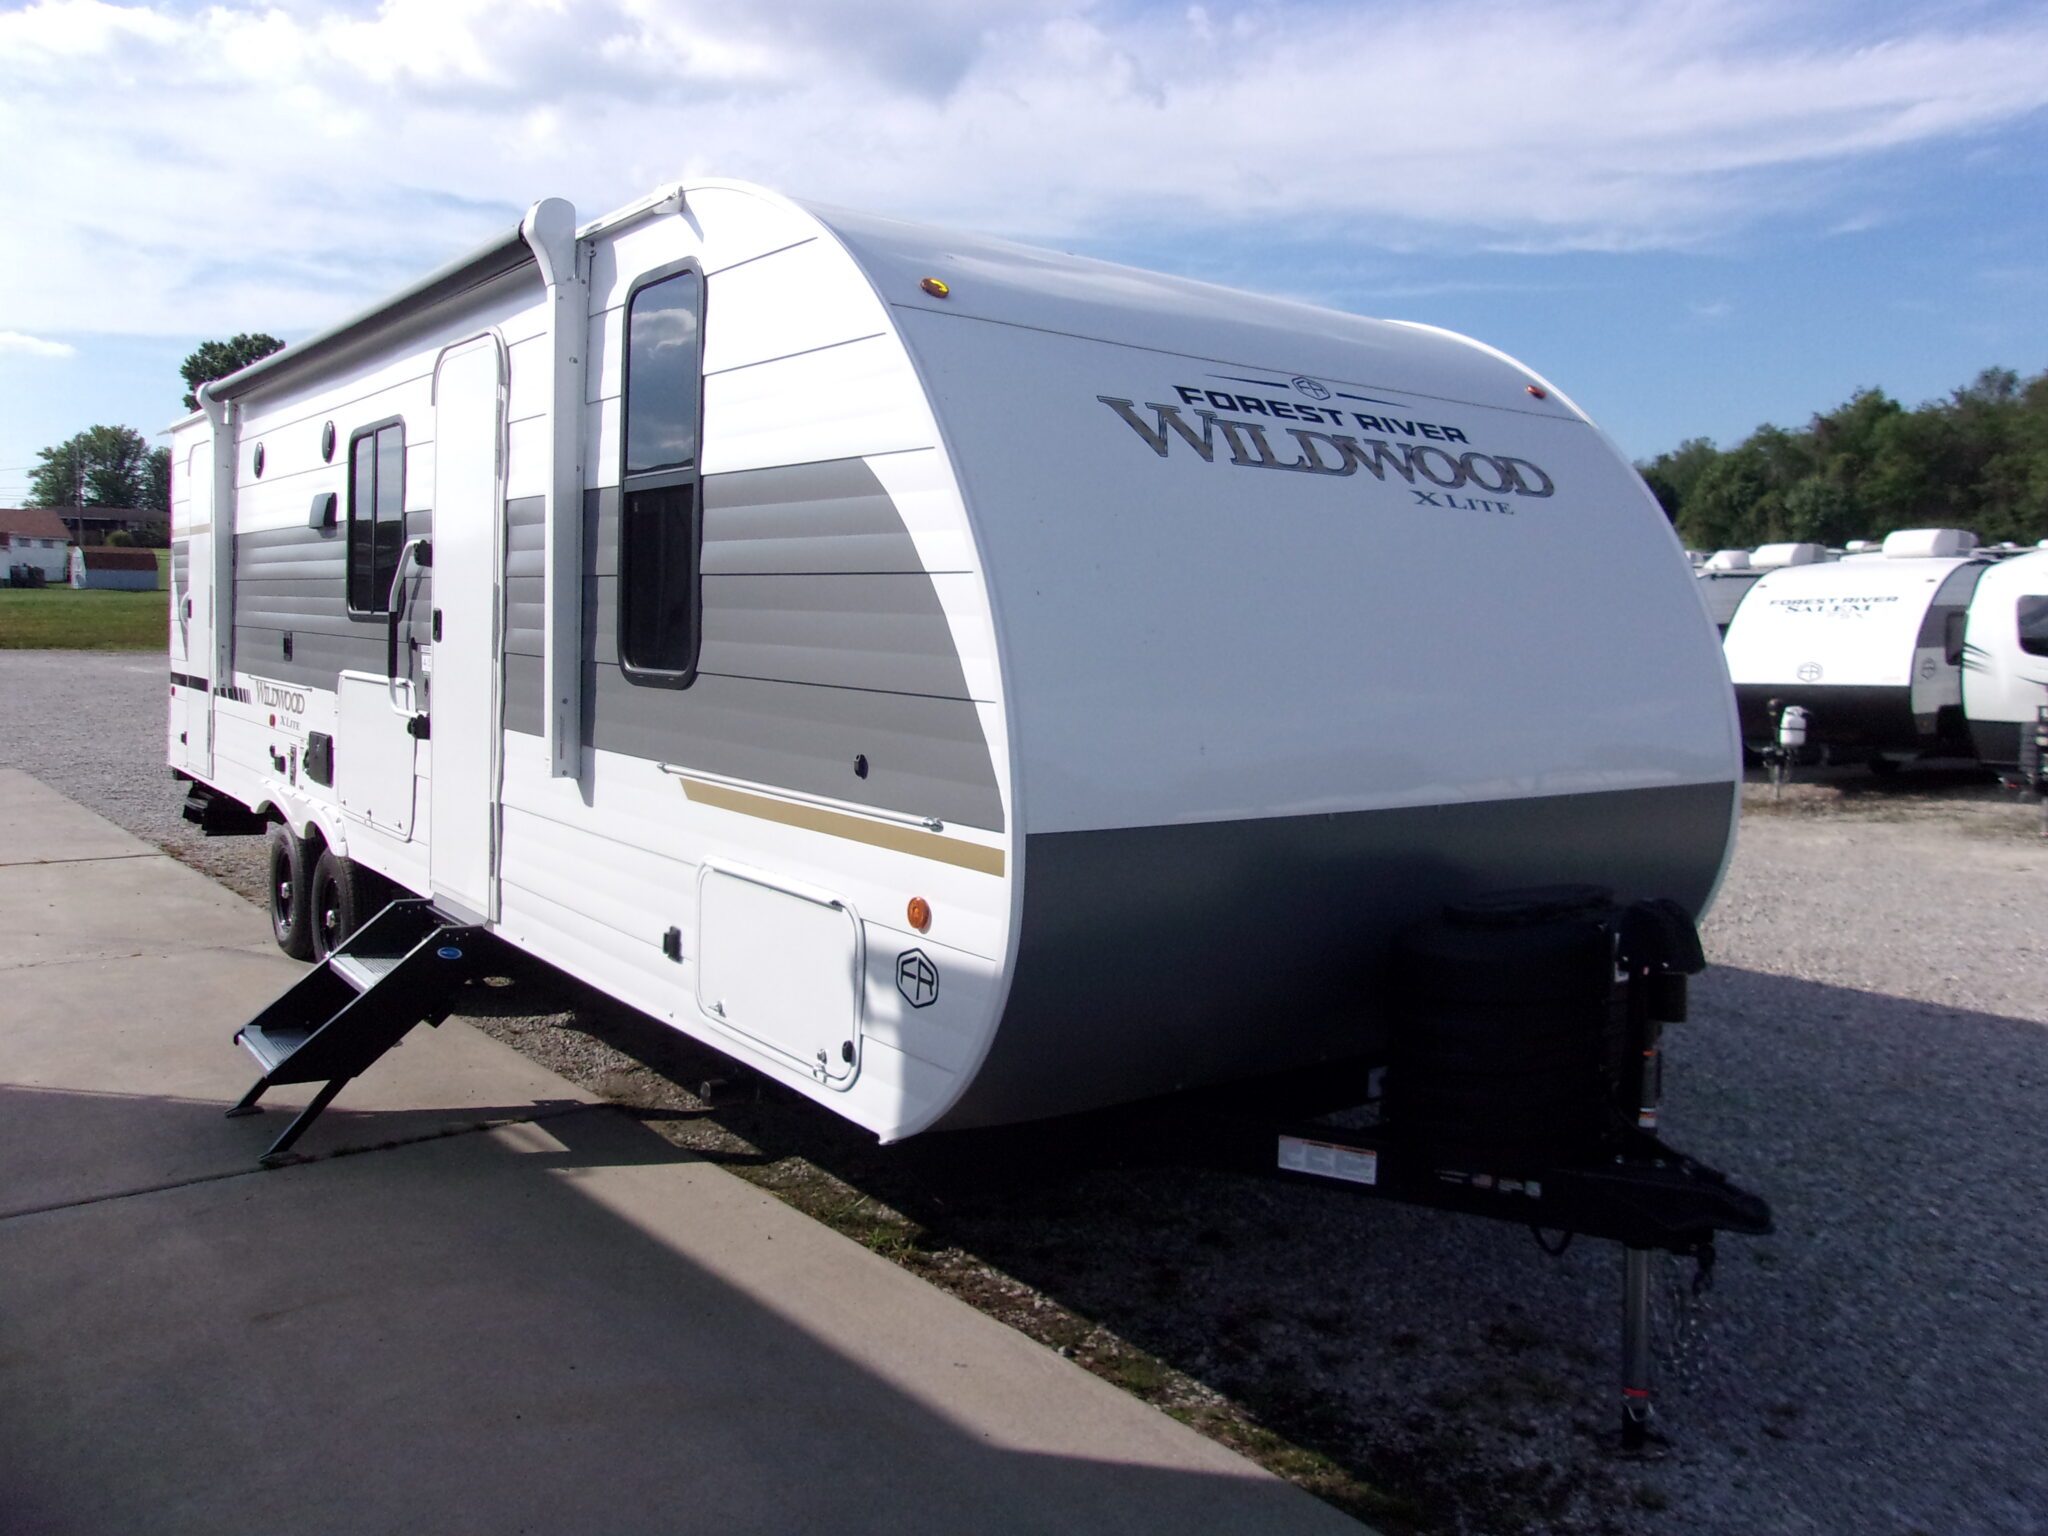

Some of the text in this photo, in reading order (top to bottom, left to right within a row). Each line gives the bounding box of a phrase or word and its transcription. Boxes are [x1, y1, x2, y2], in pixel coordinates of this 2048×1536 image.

[1171, 385, 1471, 445] FOREST RIVER
[1096, 394, 1555, 499] WILDWOOD
[256, 680, 306, 715] WILDWOOD
